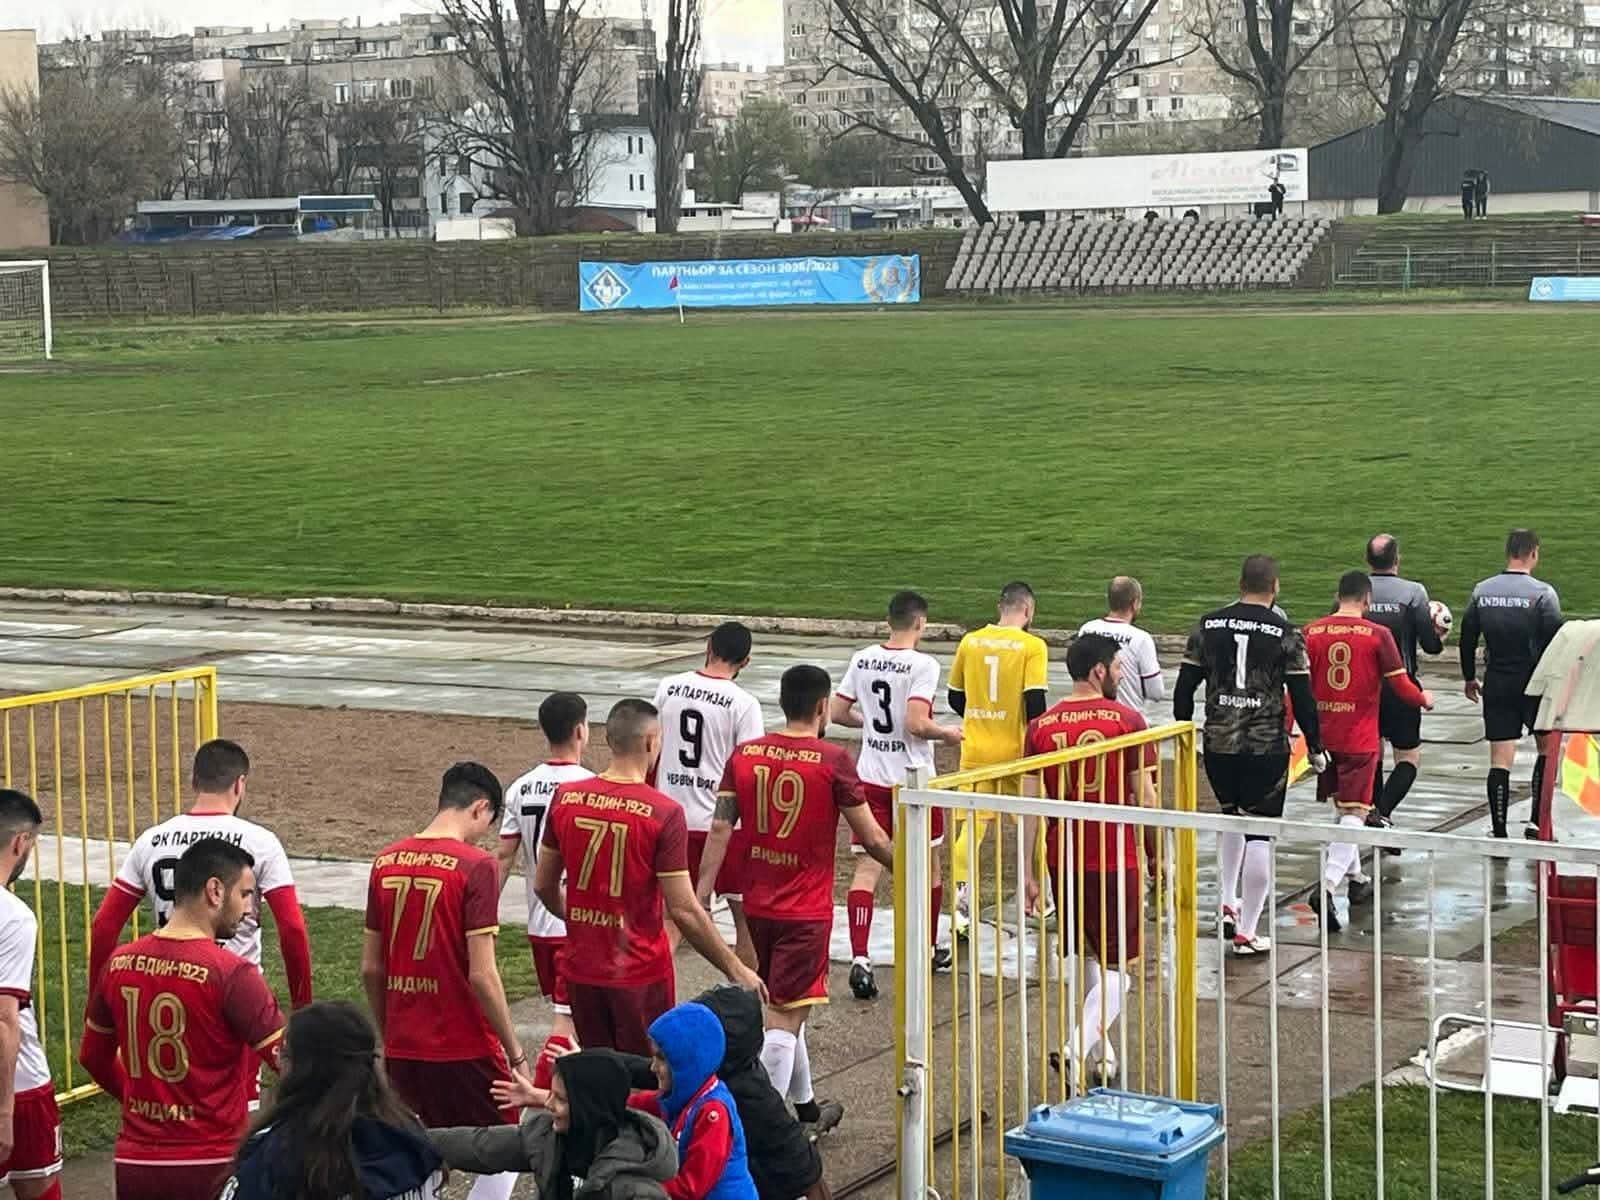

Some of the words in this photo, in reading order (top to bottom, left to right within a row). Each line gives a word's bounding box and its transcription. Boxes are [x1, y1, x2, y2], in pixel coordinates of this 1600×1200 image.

[652, 264, 715, 277] ПАРТНЬОР
[719, 264, 735, 276] ЗА
[735, 263, 776, 275] СЕЗОН
[1369, 602, 1401, 613] REWS
[1477, 596, 1531, 609] ANDREWS
[1228, 618, 1283, 637] БДИН-1923
[1233, 633, 1249, 690] 1
[1327, 641, 1352, 691] 8
[983, 655, 999, 704] 1
[682, 685, 735, 709] ПАРТИЗАН
[871, 679, 894, 734] 3
[1219, 694, 1262, 709] ВИДИН
[1062, 709, 1121, 724] БДИН-1923
[678, 708, 705, 769] 9
[766, 746, 822, 763] БДИН-1923
[535, 781, 560, 795] ПАРТ
[586, 792, 653, 817] БДИН-1923
[753, 764, 805, 839] 19
[152, 832, 170, 847] ФК
[398, 851, 459, 871] БДИН-1923
[574, 816, 628, 897] 71
[751, 846, 798, 866] ВИДИН
[381, 876, 443, 961] 77
[570, 907, 625, 929] ВИДИН
[135, 954, 209, 984] БДИН-1923
[120, 985, 190, 1084] 18
